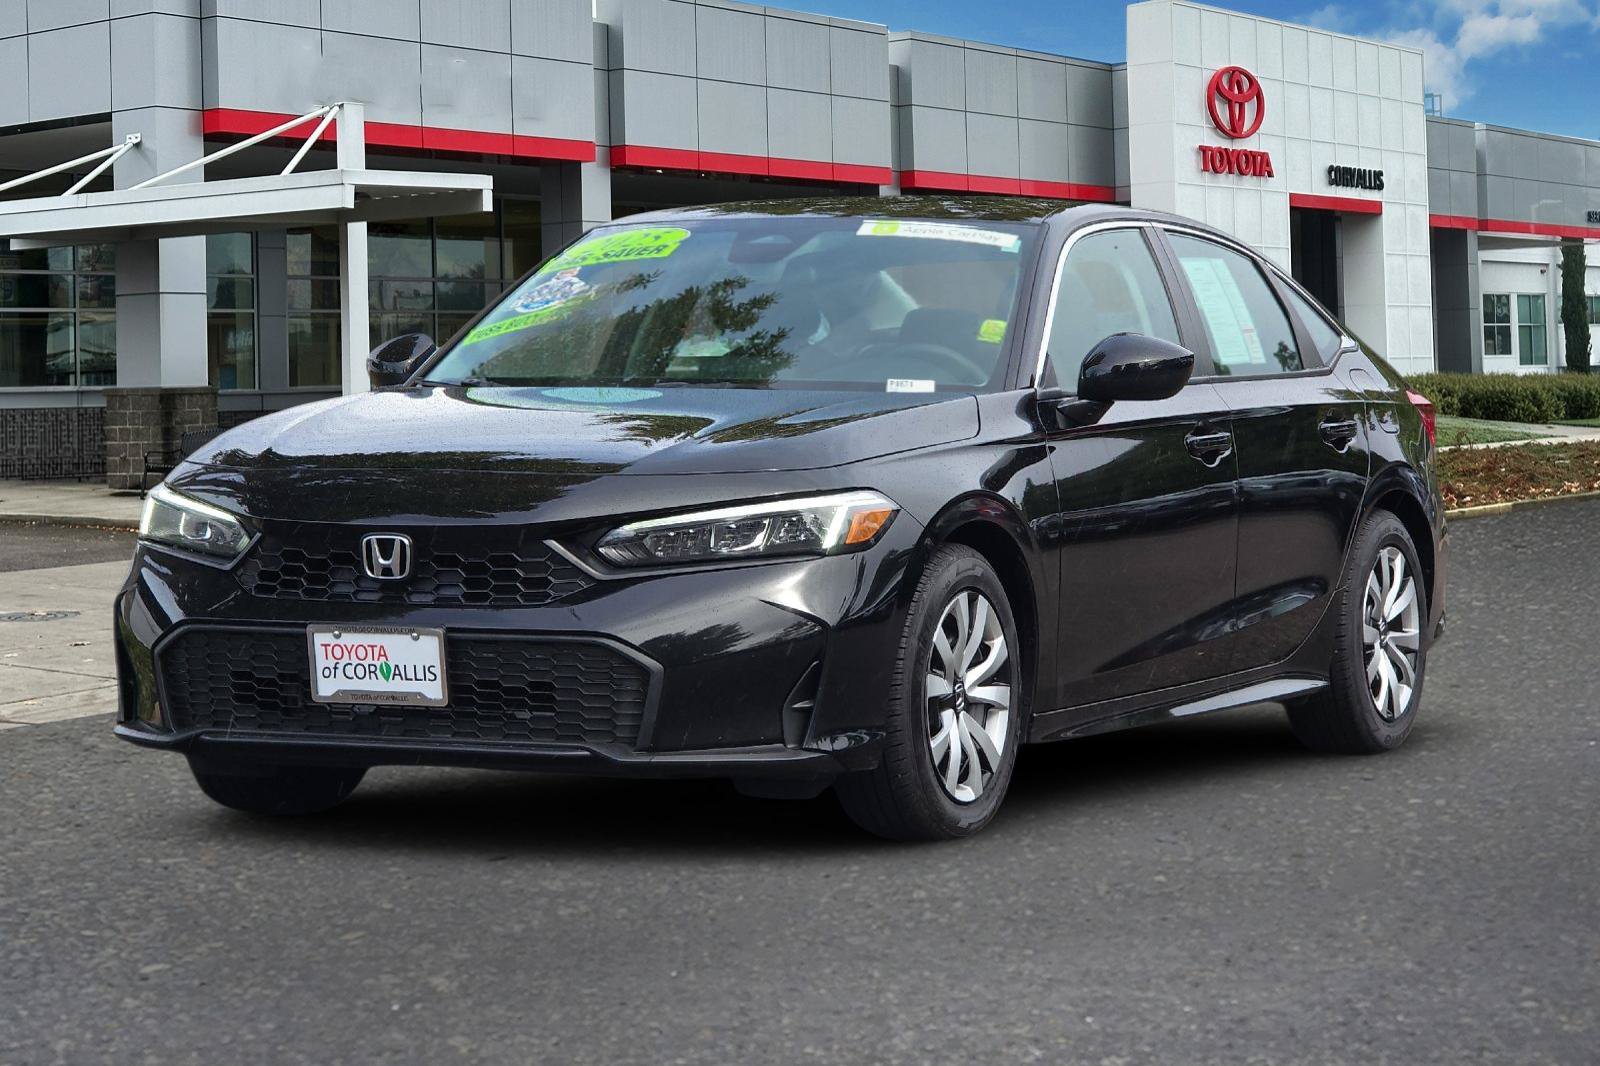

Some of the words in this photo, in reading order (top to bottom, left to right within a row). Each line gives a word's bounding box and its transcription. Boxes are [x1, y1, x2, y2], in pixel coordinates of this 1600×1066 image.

[1198, 145, 1274, 178] TOYOTA
[1327, 164, 1385, 191] CORVALLIS
[320, 643, 389, 661] TOYOTA
[322, 662, 340, 679] of
[343, 661, 438, 682] CORVALLIS
